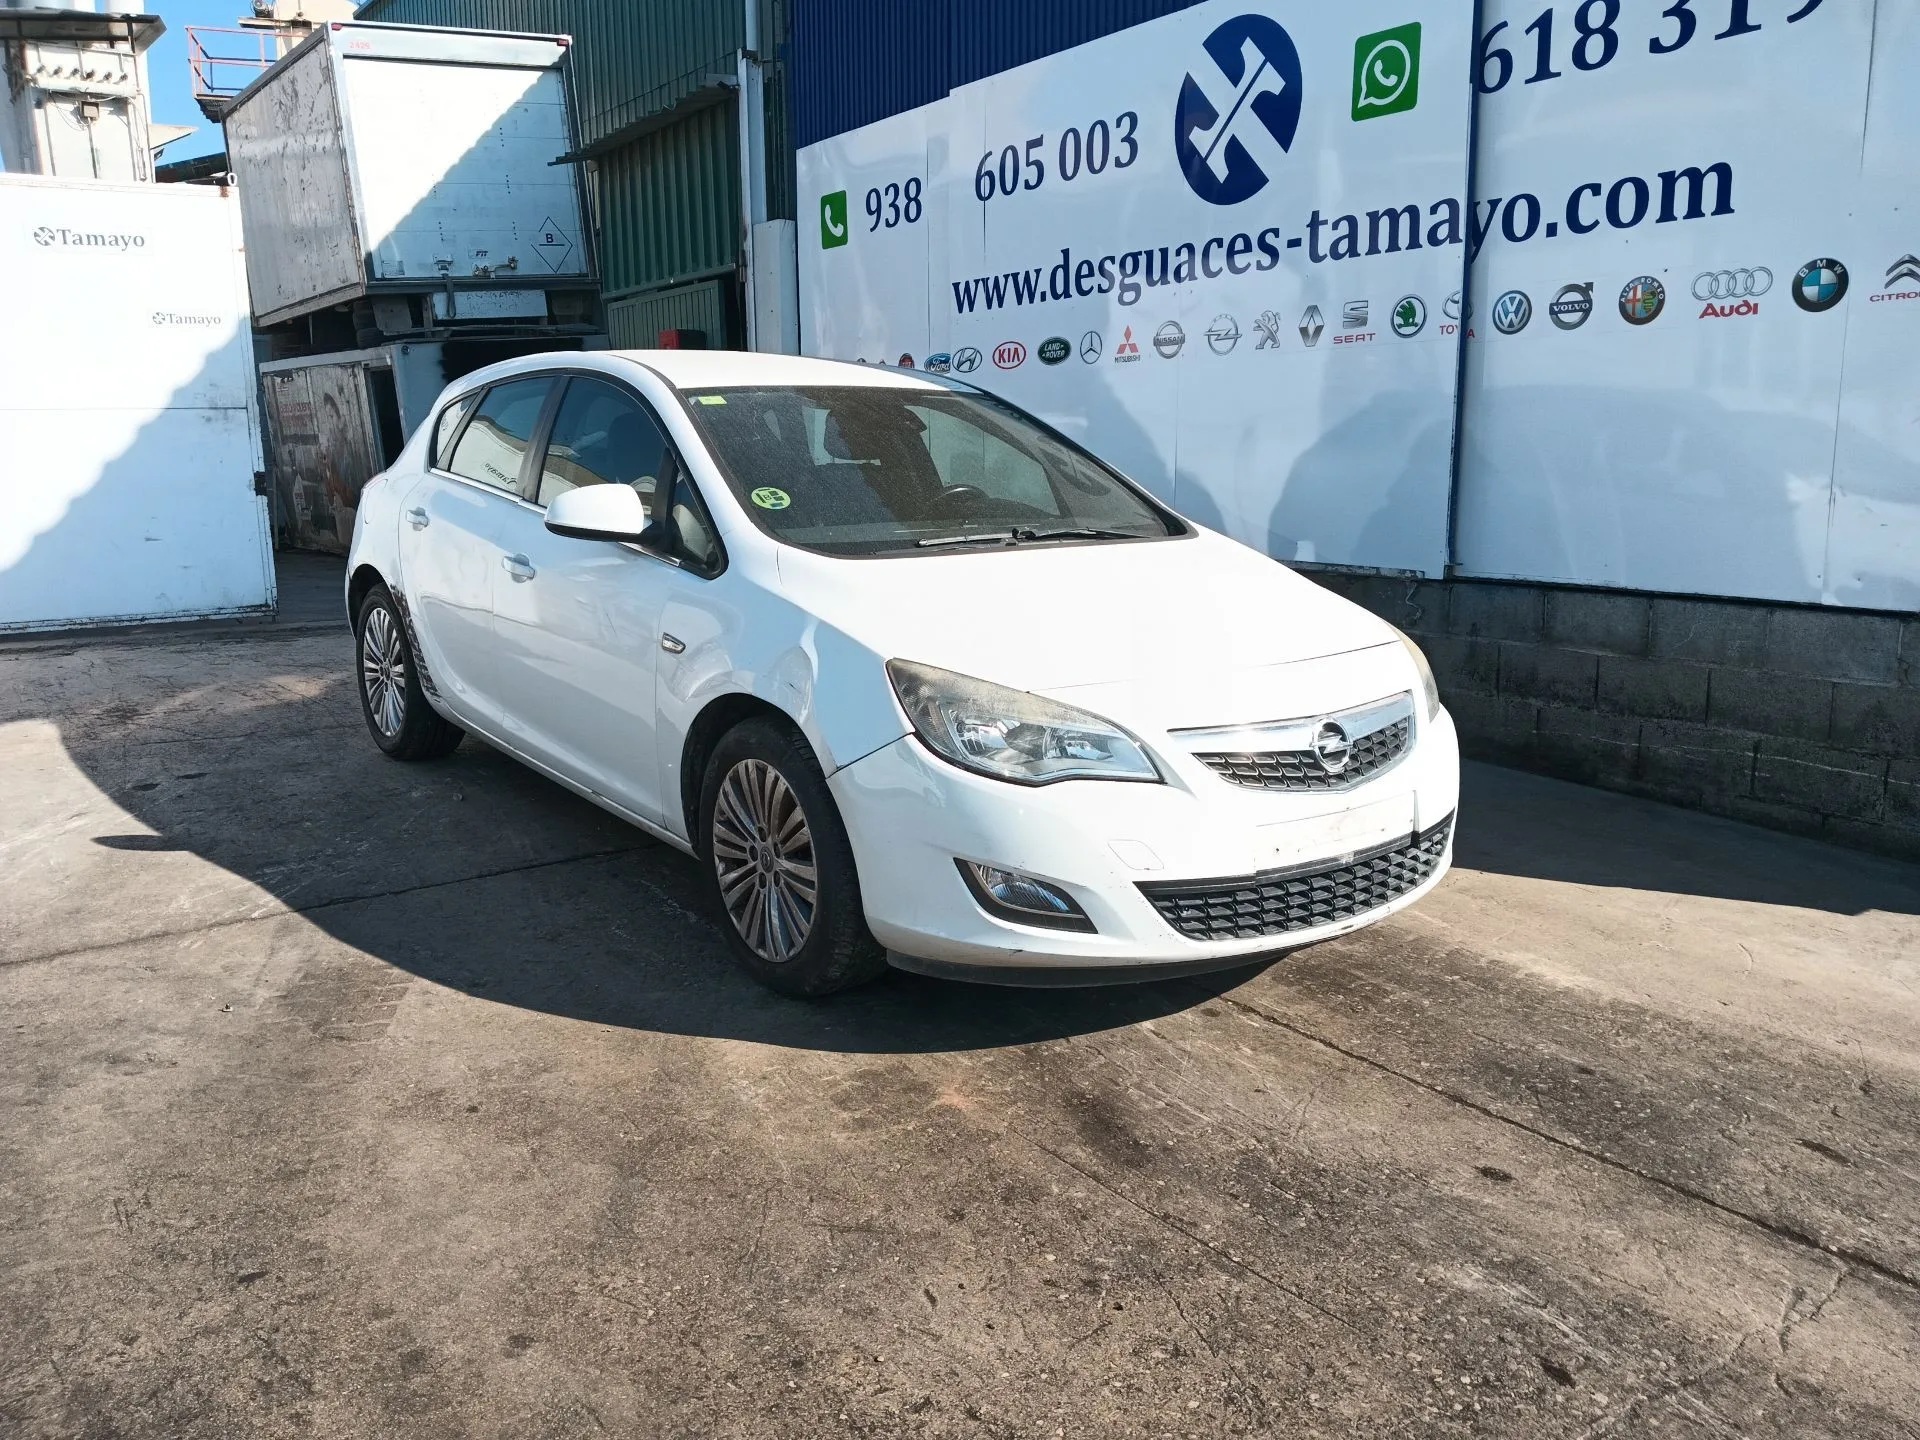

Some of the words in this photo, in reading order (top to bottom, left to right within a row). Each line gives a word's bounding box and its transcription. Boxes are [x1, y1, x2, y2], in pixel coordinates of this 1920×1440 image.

[1478, 0, 1620, 94] 618
[1649, 0, 1825, 54] 31
[865, 177, 922, 233] 938
[975, 134, 1045, 201] 605
[1059, 111, 1139, 182] 003
[56, 228, 145, 252] Tamayo
[545, 233, 554, 243] B
[952, 161, 1736, 315] www.desguaces-tamayo.com
[1798, 259, 1845, 278] BMW
[1869, 291, 1920, 302] CITRO
[1552, 301, 1590, 312] VOLVO
[166, 313, 221, 328] Tamayo
[1156, 334, 1184, 346] NISSAN
[1333, 332, 1376, 345] SEAT
[1044, 343, 1061, 351] LAND
[998, 347, 1021, 364] KIA
[1046, 350, 1065, 360] ROVER
[1114, 354, 1141, 364] MITSUBISHI
